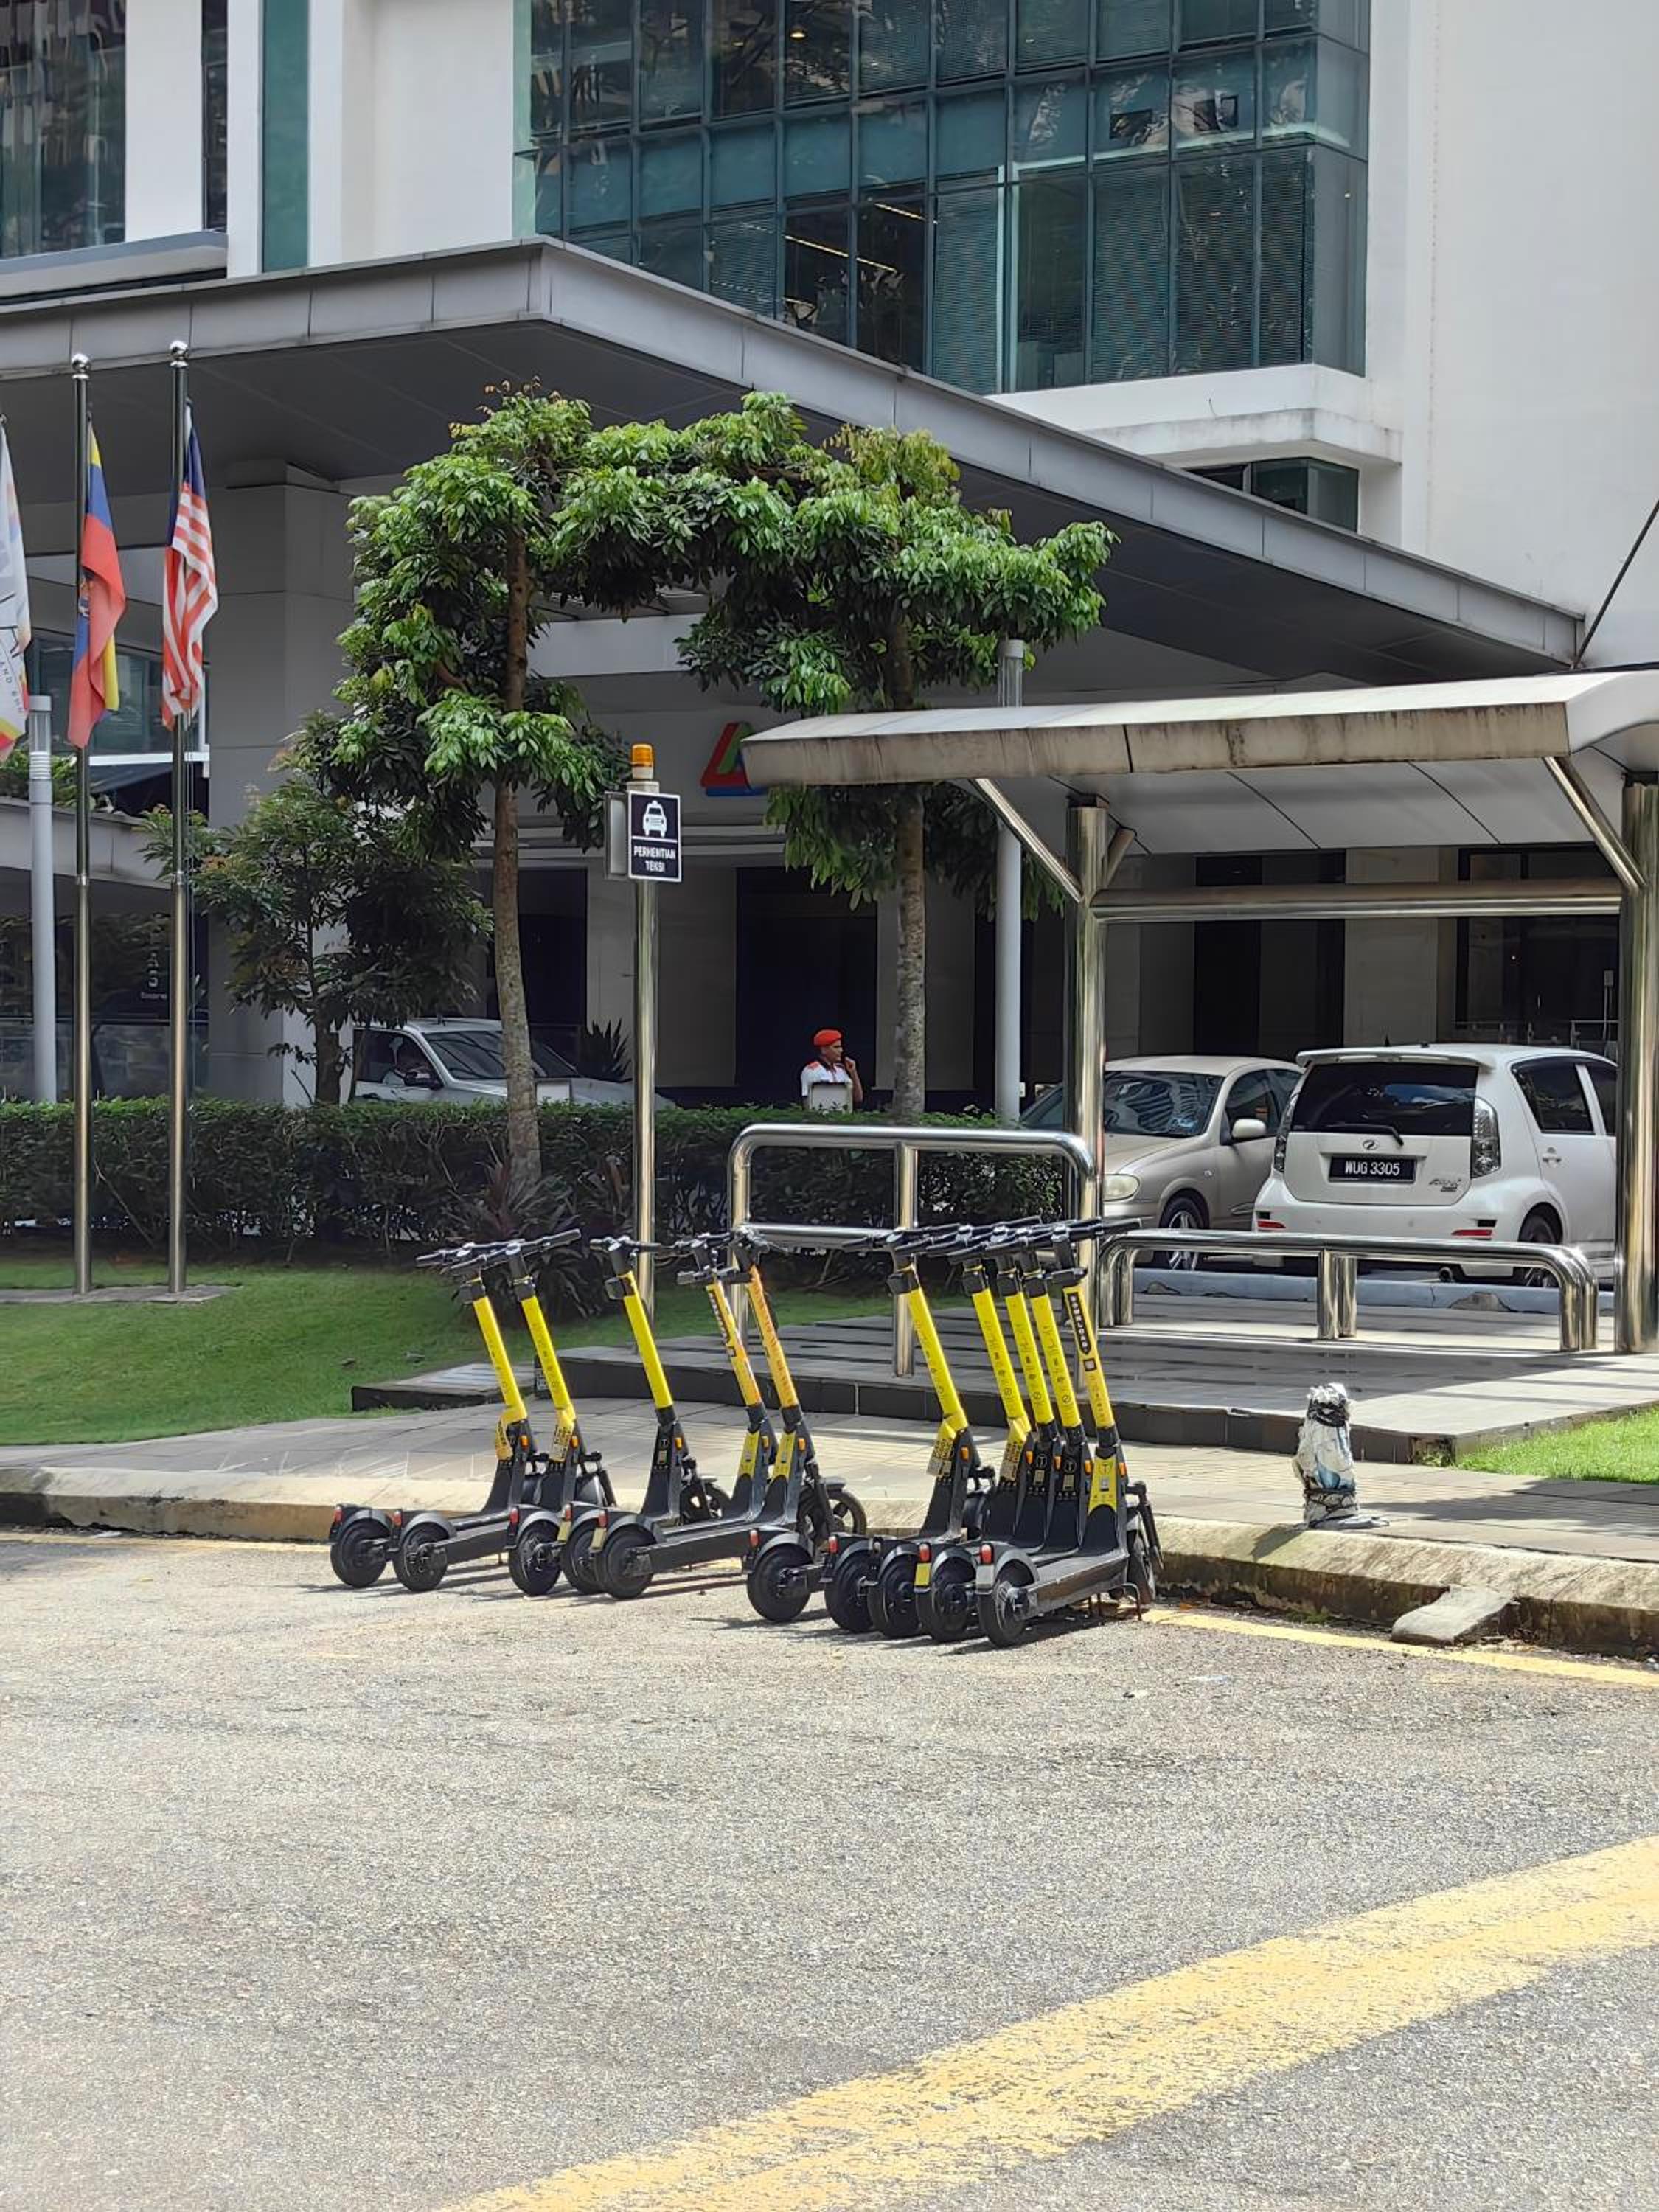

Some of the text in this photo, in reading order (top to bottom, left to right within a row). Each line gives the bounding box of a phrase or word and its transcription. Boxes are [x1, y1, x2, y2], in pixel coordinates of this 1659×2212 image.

[633, 846, 676, 859] PERHENTIAN
[645, 860, 665, 873] TEKSI
[1344, 1161, 1400, 1176] WUG 3305
